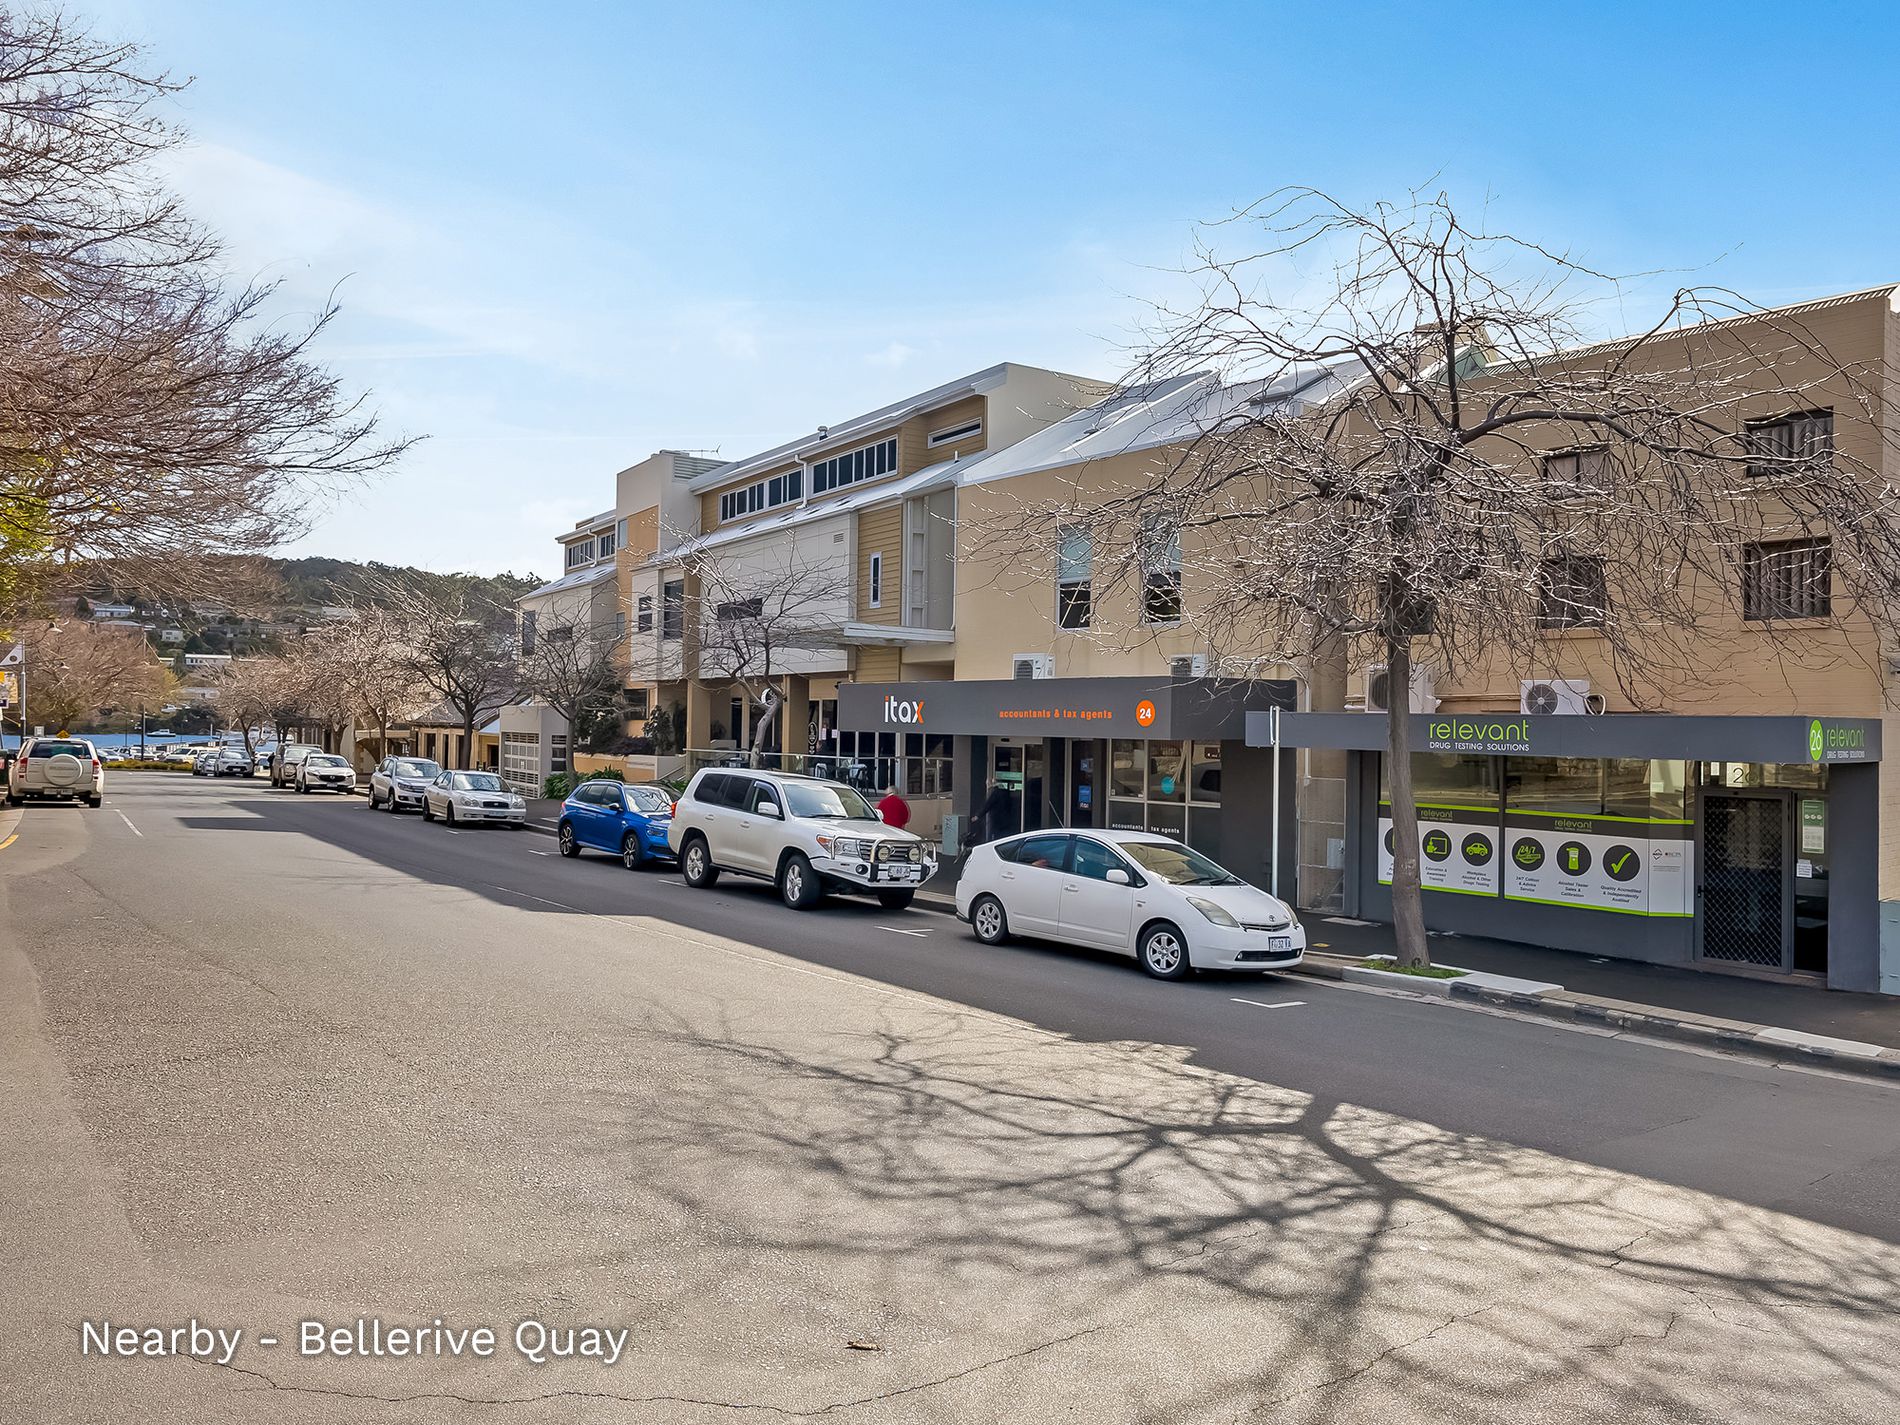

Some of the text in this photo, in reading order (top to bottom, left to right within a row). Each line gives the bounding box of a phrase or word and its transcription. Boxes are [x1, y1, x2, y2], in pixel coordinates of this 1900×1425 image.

[884, 695, 925, 724] itax
[999, 708, 1113, 721] accountants & tax agents
[1139, 708, 1152, 719] 24
[1429, 719, 1529, 741] relevant
[1826, 723, 1865, 748] relevant
[1810, 729, 1822, 751] 26
[1429, 741, 1530, 752] DRUG TESTING SOLUTIONS
[1420, 809, 1453, 818] relevant
[1112, 823, 1144, 831] accountants
[1554, 819, 1592, 829] relevant
